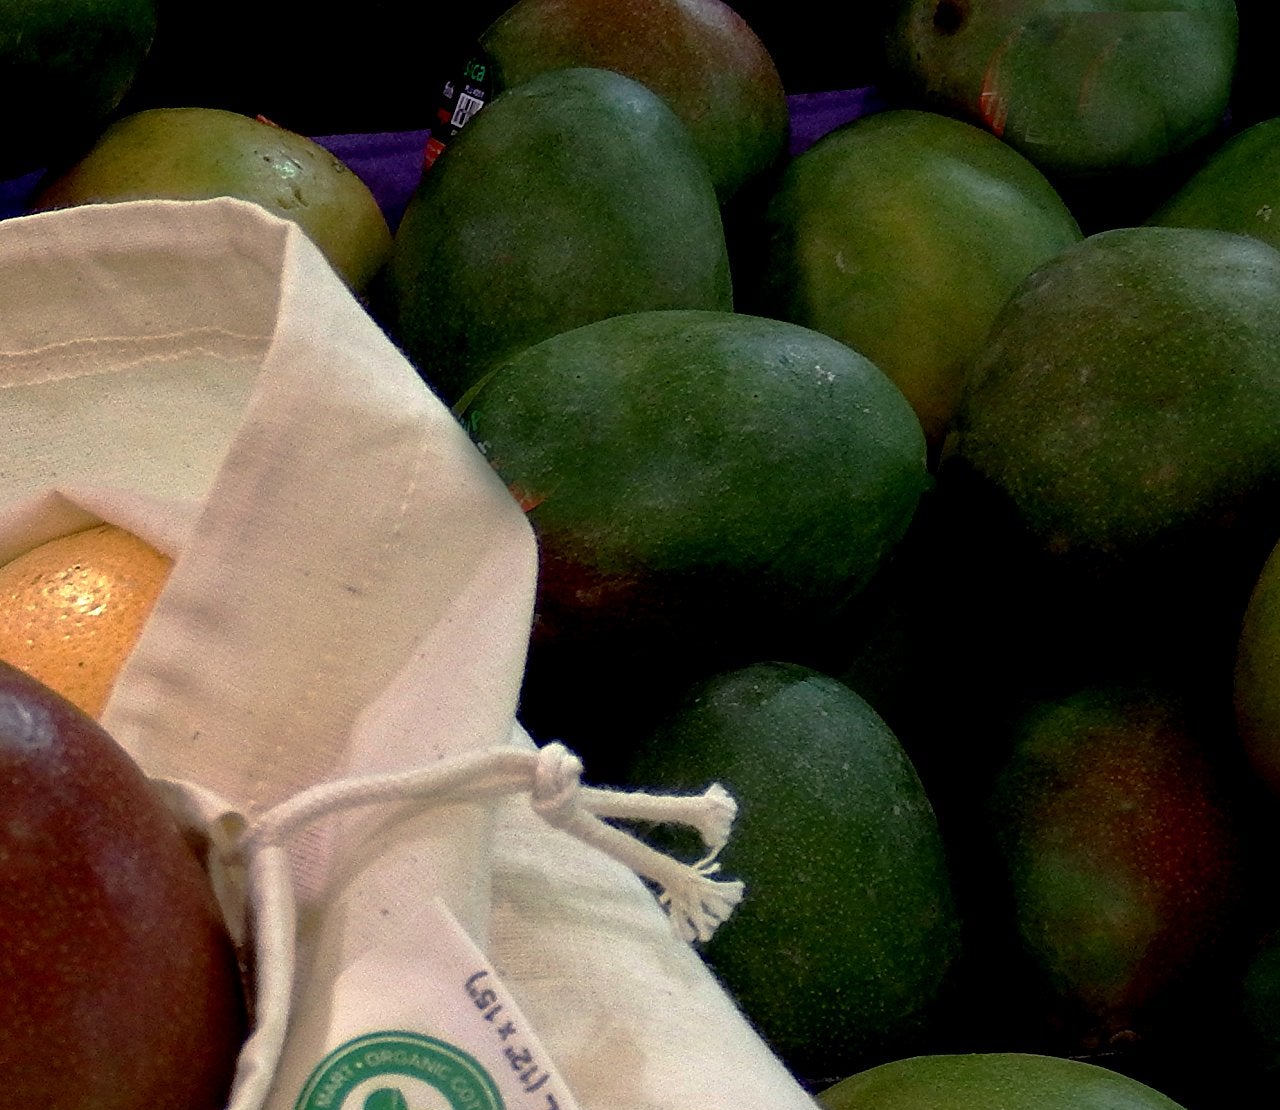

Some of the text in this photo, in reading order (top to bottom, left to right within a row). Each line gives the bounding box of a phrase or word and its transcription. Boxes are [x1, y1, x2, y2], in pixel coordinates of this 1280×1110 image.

[498, 1022, 516, 1041] x
[364, 1050, 452, 1078] ORGANIC
[314, 1064, 356, 1108] MART
